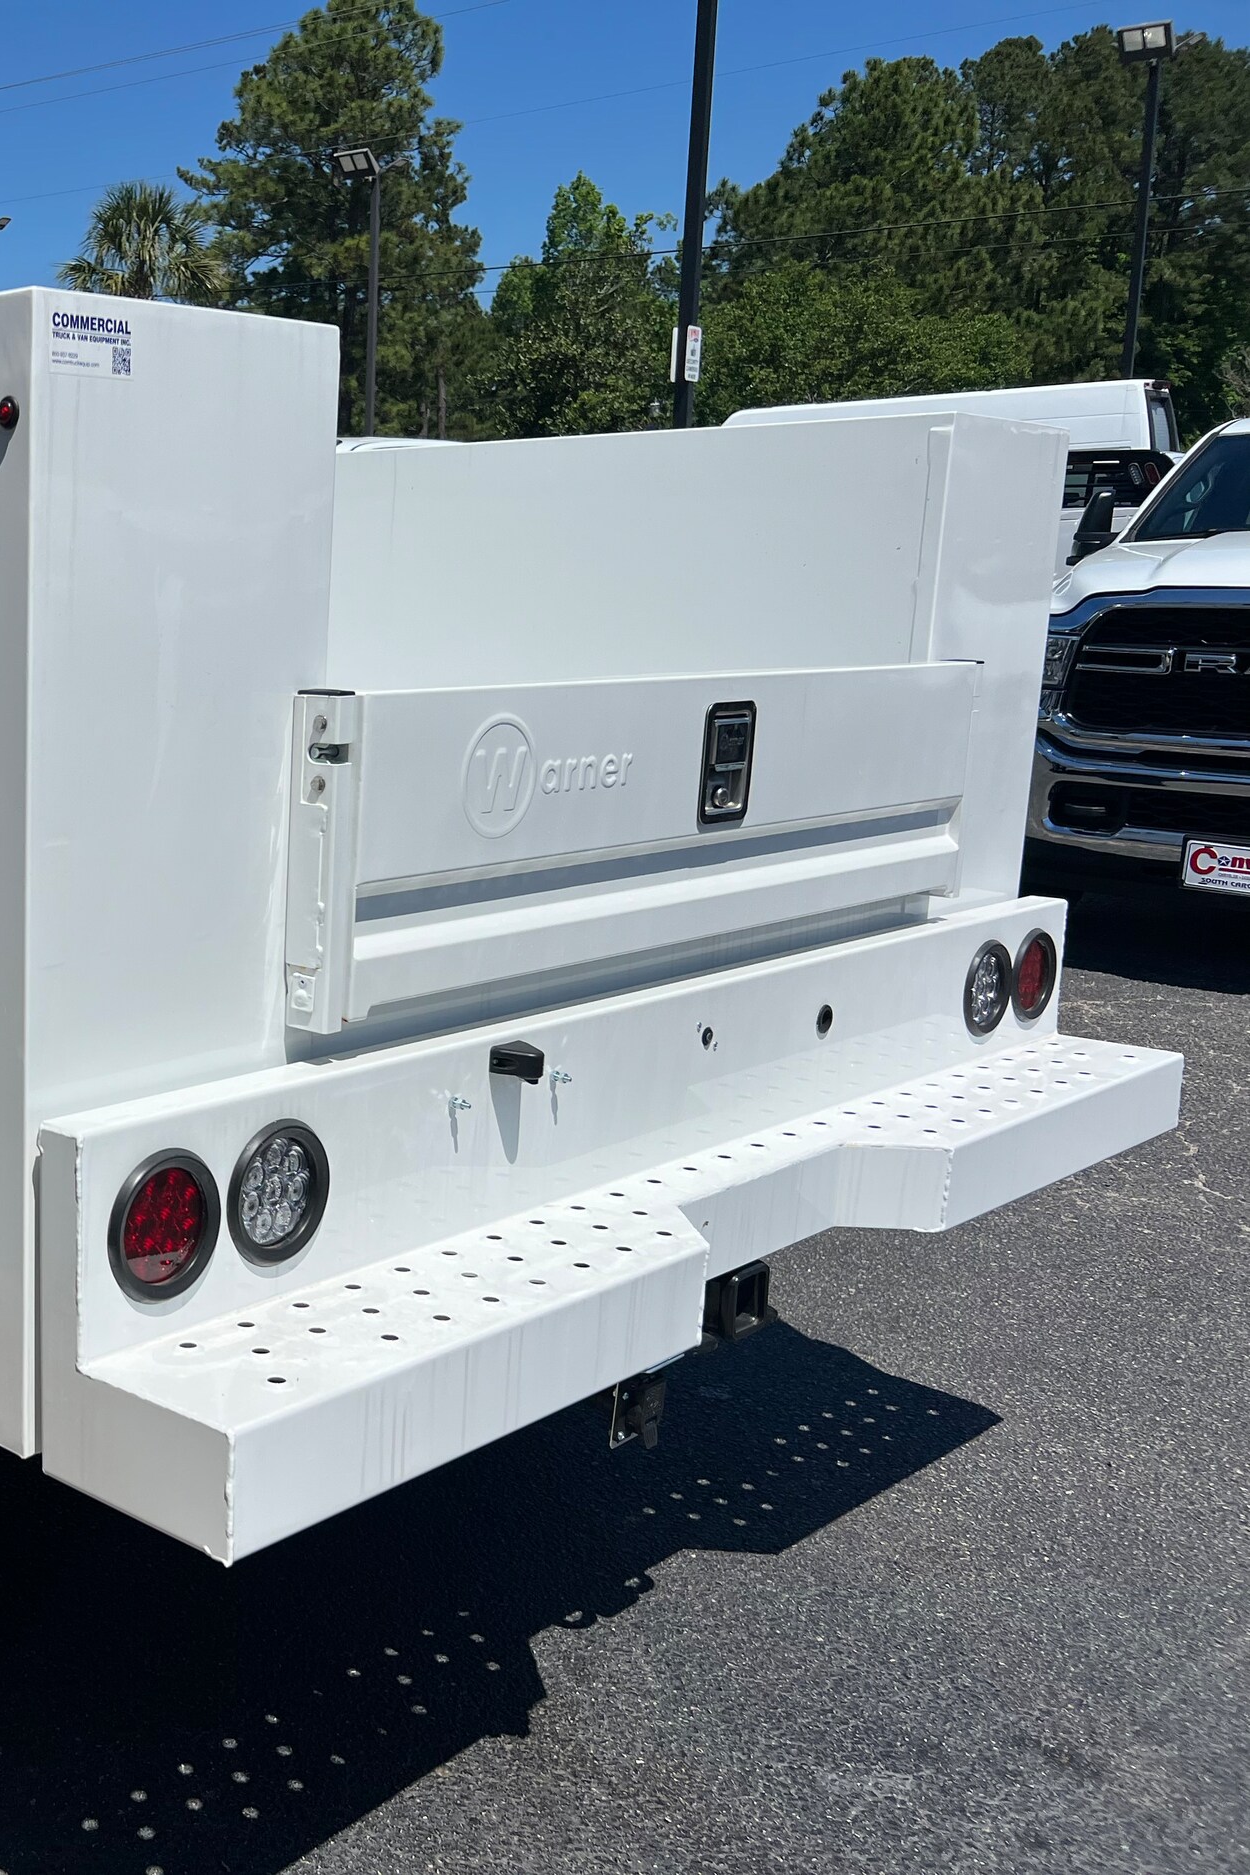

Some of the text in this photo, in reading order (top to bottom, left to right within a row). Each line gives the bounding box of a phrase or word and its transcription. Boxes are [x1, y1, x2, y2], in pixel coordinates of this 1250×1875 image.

[52, 312, 131, 335] COMMERCIAL
[52, 331, 70, 340] TRUCK
[77, 334, 88, 342] VAN
[89, 336, 120, 346] EQUIPMENT
[472, 740, 634, 818] Warner
[1200, 877, 1228, 886] SOUTH
